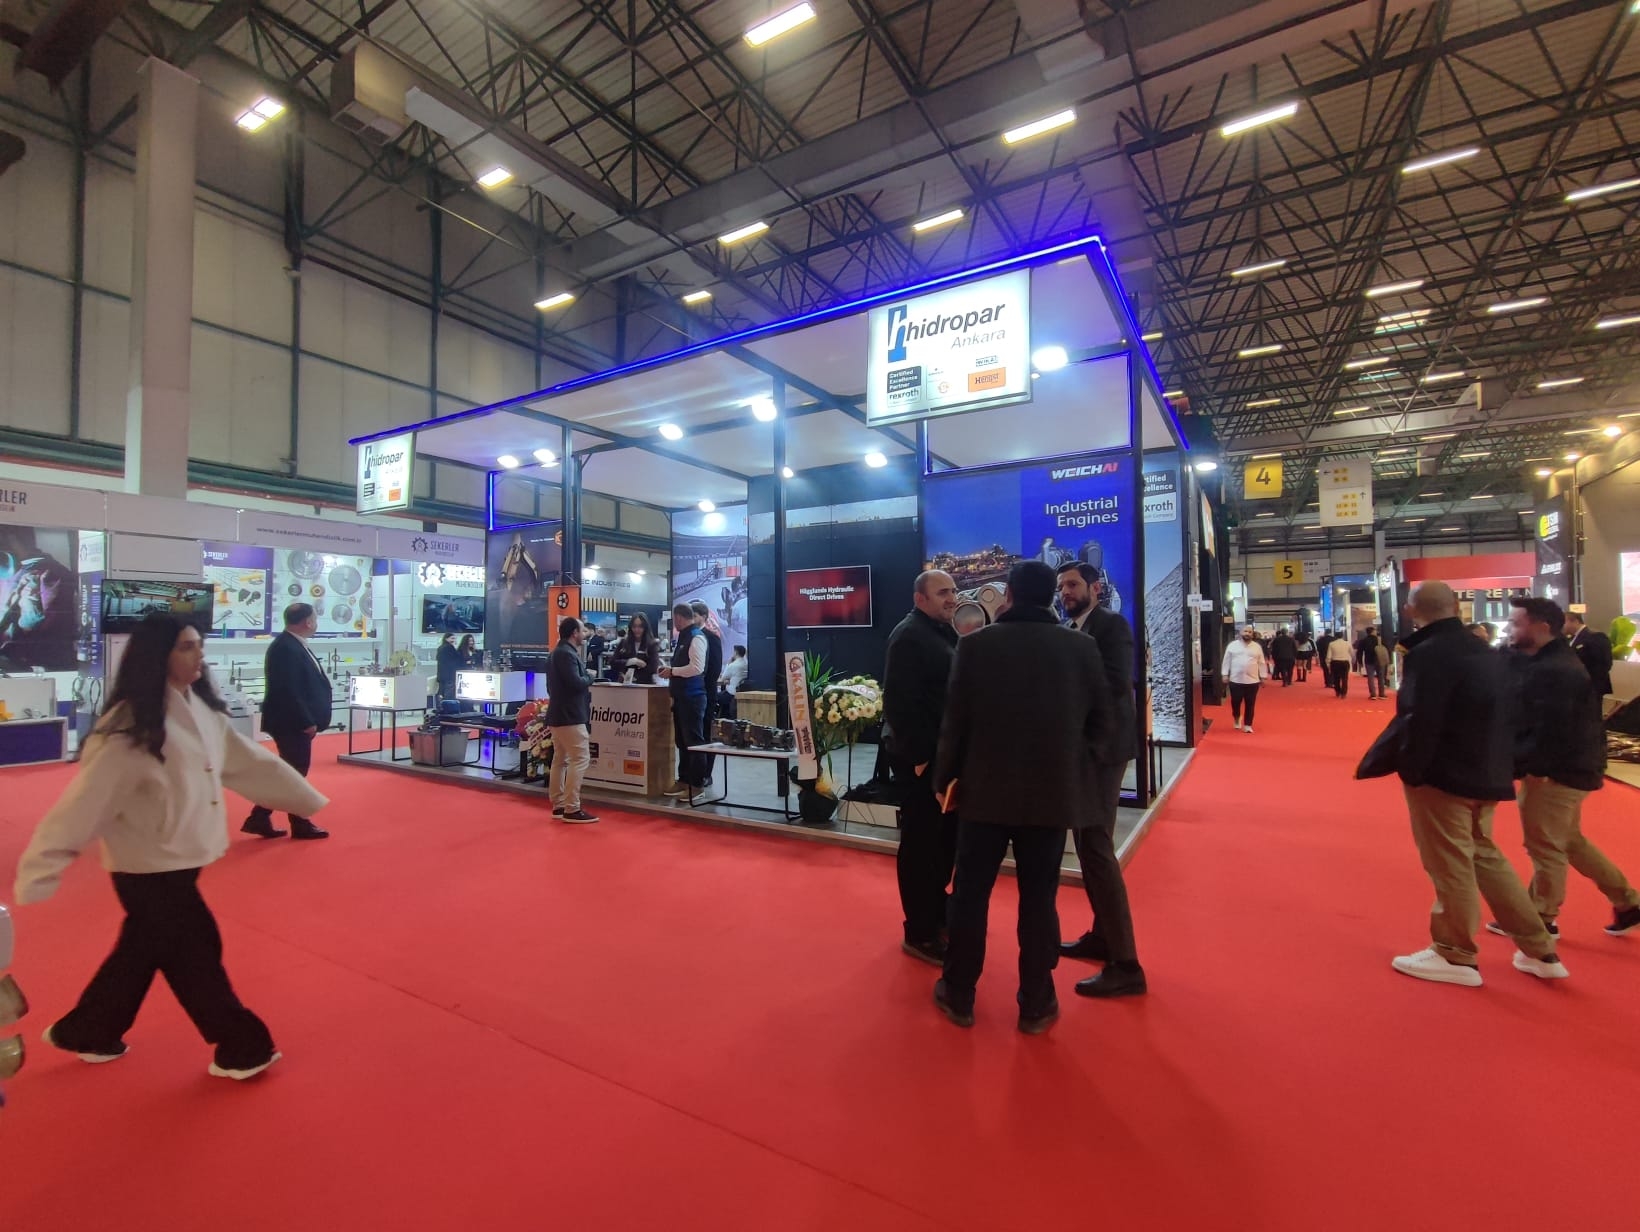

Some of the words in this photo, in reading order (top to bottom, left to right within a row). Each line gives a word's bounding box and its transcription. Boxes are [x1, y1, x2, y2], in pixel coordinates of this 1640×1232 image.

[905, 303, 1006, 341] hidropar
[951, 329, 1006, 350] Ankara
[889, 369, 914, 379] Certified
[889, 375, 918, 385] Excellence
[889, 382, 911, 391] Partner
[889, 388, 920, 400] rexroth
[370, 452, 404, 468] hidropar
[1051, 461, 1119, 480] WEICHAI
[1255, 466, 1271, 486] 4
[1045, 495, 1118, 515] Industrial
[1057, 512, 1119, 528] Engines
[1283, 565, 1294, 579] 5
[590, 706, 645, 727] hidropar
[614, 727, 645, 740] Ankara
